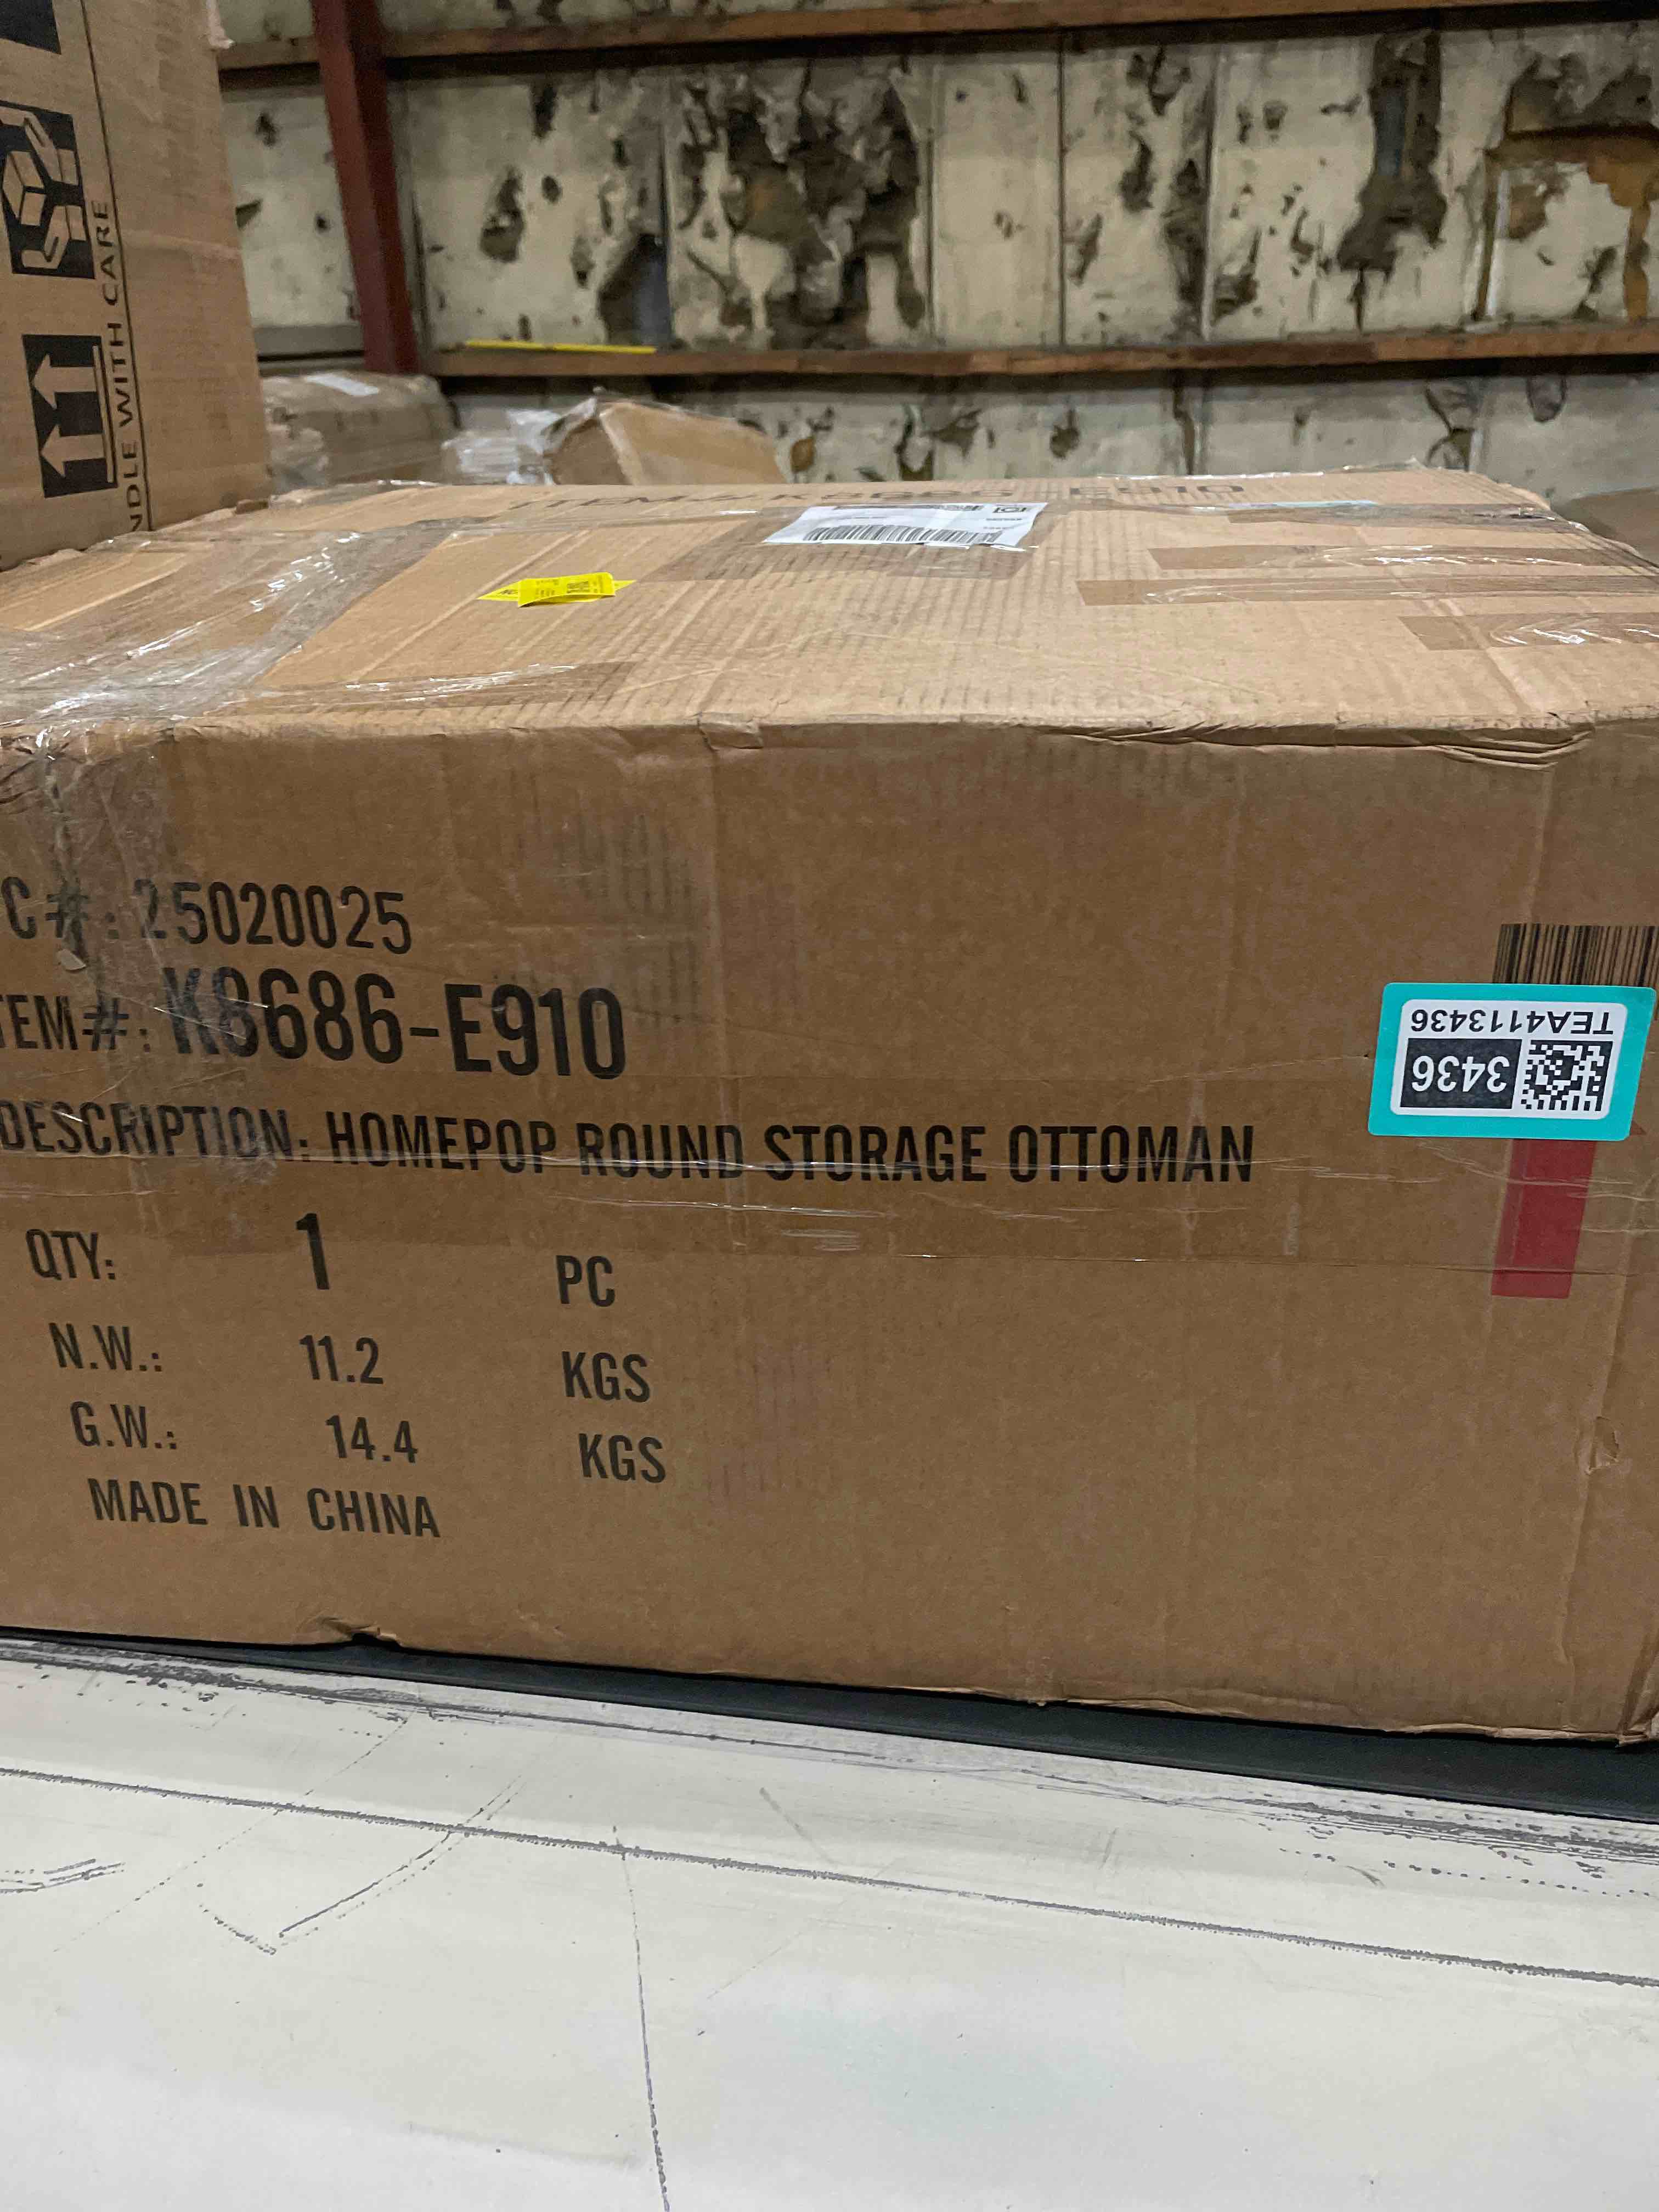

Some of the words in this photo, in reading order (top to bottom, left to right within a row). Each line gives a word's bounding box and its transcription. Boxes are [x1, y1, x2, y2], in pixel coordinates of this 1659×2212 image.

[93, 199, 120, 307] CARE
[107, 322, 134, 428] WITH
[133, 878, 412, 955] 25020025
[163, 966, 627, 1080] K8686-E910
[1410, 1008, 1613, 1036] TEA4113436
[1412, 1055, 1510, 1093] 3436
[326, 1110, 556, 1174] HOMEPOP
[576, 1122, 744, 1180] ROUND
[764, 1125, 987, 1183] STORAGE
[1008, 1125, 1254, 1183] OTTOMAN
[25, 1228, 116, 1280] QTY:
[296, 1213, 330, 1290] 1
[555, 1255, 616, 1307] PC
[48, 1322, 162, 1372] N.W.:
[299, 1335, 384, 1385] 11.2
[561, 1351, 651, 1403] KGS
[70, 1401, 178, 1449] G.W.:
[325, 1415, 419, 1463] 14.4
[579, 1432, 667, 1483] KGS
[87, 1478, 208, 1525] MADE
[233, 1484, 280, 1528] IN
[307, 1487, 441, 1538] CHINA
